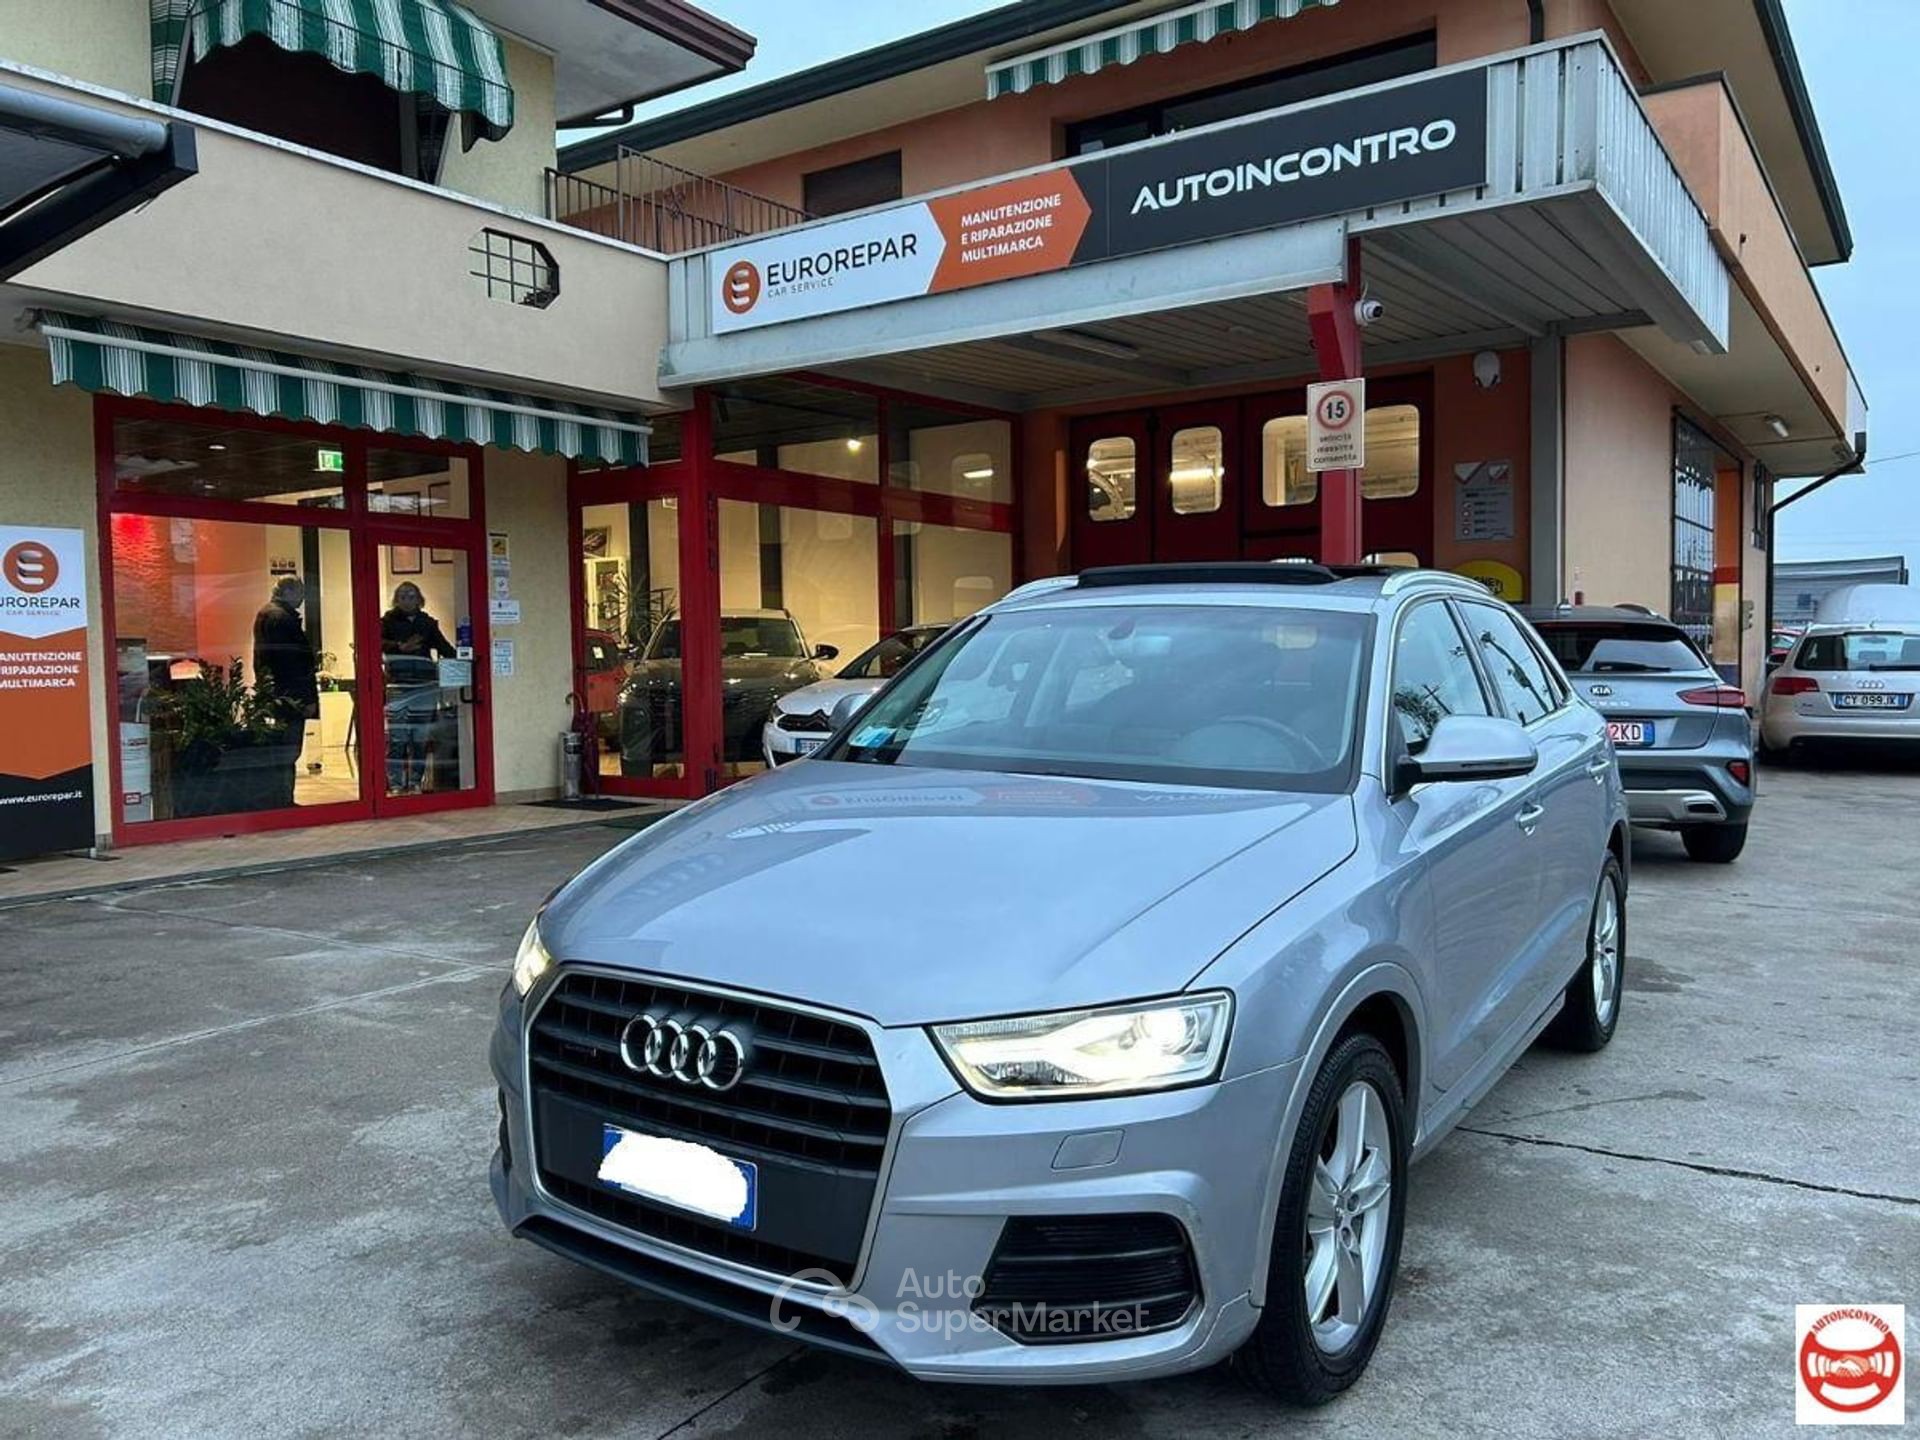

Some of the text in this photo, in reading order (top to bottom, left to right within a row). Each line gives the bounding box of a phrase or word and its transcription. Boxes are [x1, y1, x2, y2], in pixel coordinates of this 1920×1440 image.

[1130, 118, 1457, 215] AUTOINCONTRO
[961, 193, 1062, 229] MANUTENZIONE
[961, 214, 1053, 245] E RIPARAZIONE
[767, 233, 917, 287] EUROREPAR
[961, 235, 1044, 264] MULTIMARCA
[767, 276, 834, 299] CAR SERVICE
[1326, 400, 1345, 420] 15
[1, 664, 79, 675] RIPARAZIONE
[1592, 686, 1611, 695] KIA
